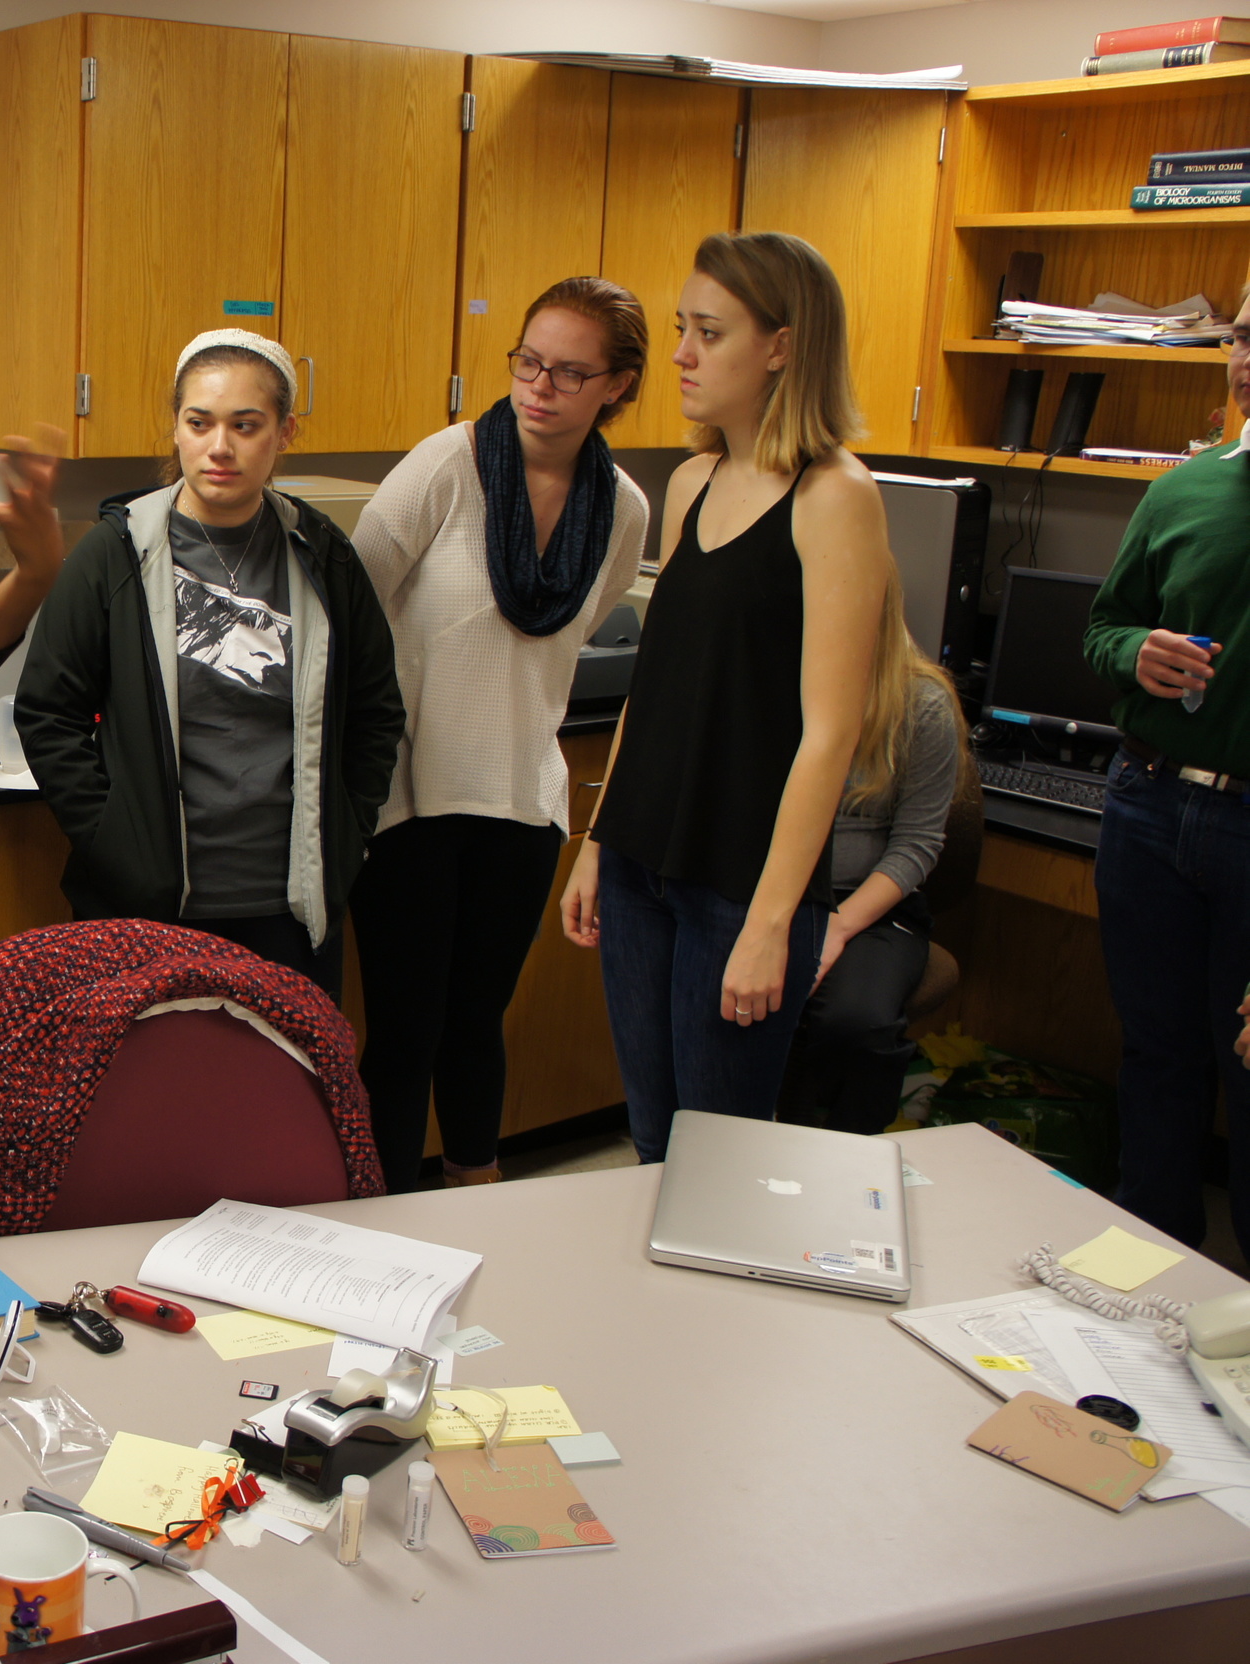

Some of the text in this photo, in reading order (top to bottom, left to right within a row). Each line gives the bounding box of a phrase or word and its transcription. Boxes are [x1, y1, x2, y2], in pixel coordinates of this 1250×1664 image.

[1183, 164, 1217, 173] MANUAL
[1218, 162, 1244, 171] DIFCO
[1155, 187, 1191, 196] BIOLOGY
[1154, 197, 1167, 205] OF
[1167, 195, 1241, 205] MICROORGANISMS
[462, 1463, 573, 1492] ALEXA
